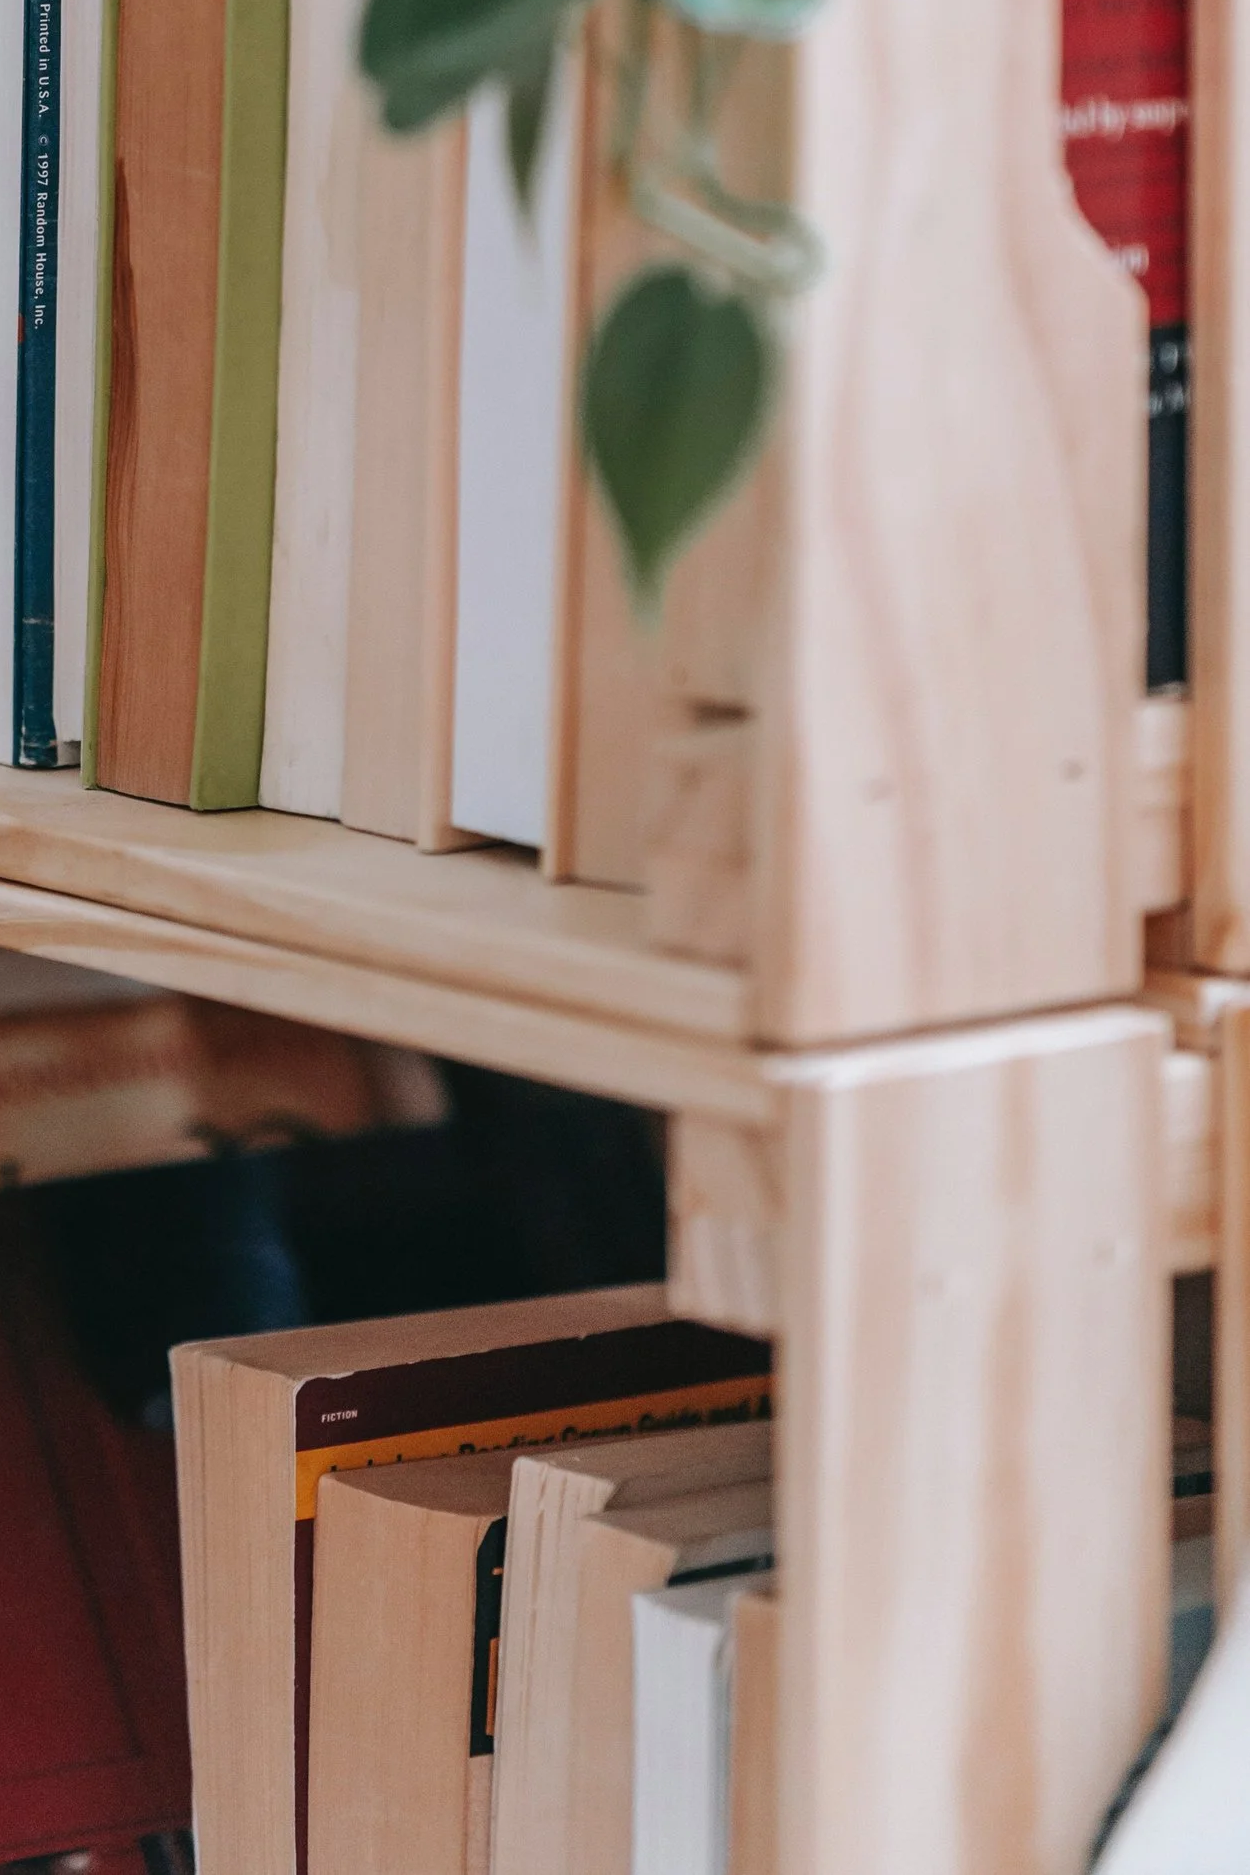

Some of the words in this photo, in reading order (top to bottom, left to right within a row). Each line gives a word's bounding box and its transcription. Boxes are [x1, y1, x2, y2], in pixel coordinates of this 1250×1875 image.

[39, 3, 50, 52] Printed
[38, 58, 49, 70] in
[38, 76, 49, 117] U.S.A.
[37, 152, 48, 185] 1997
[36, 192, 47, 246] Random
[33, 252, 46, 299] House,
[34, 304, 45, 329] Inc.
[320, 1409, 359, 1424] FICTION
